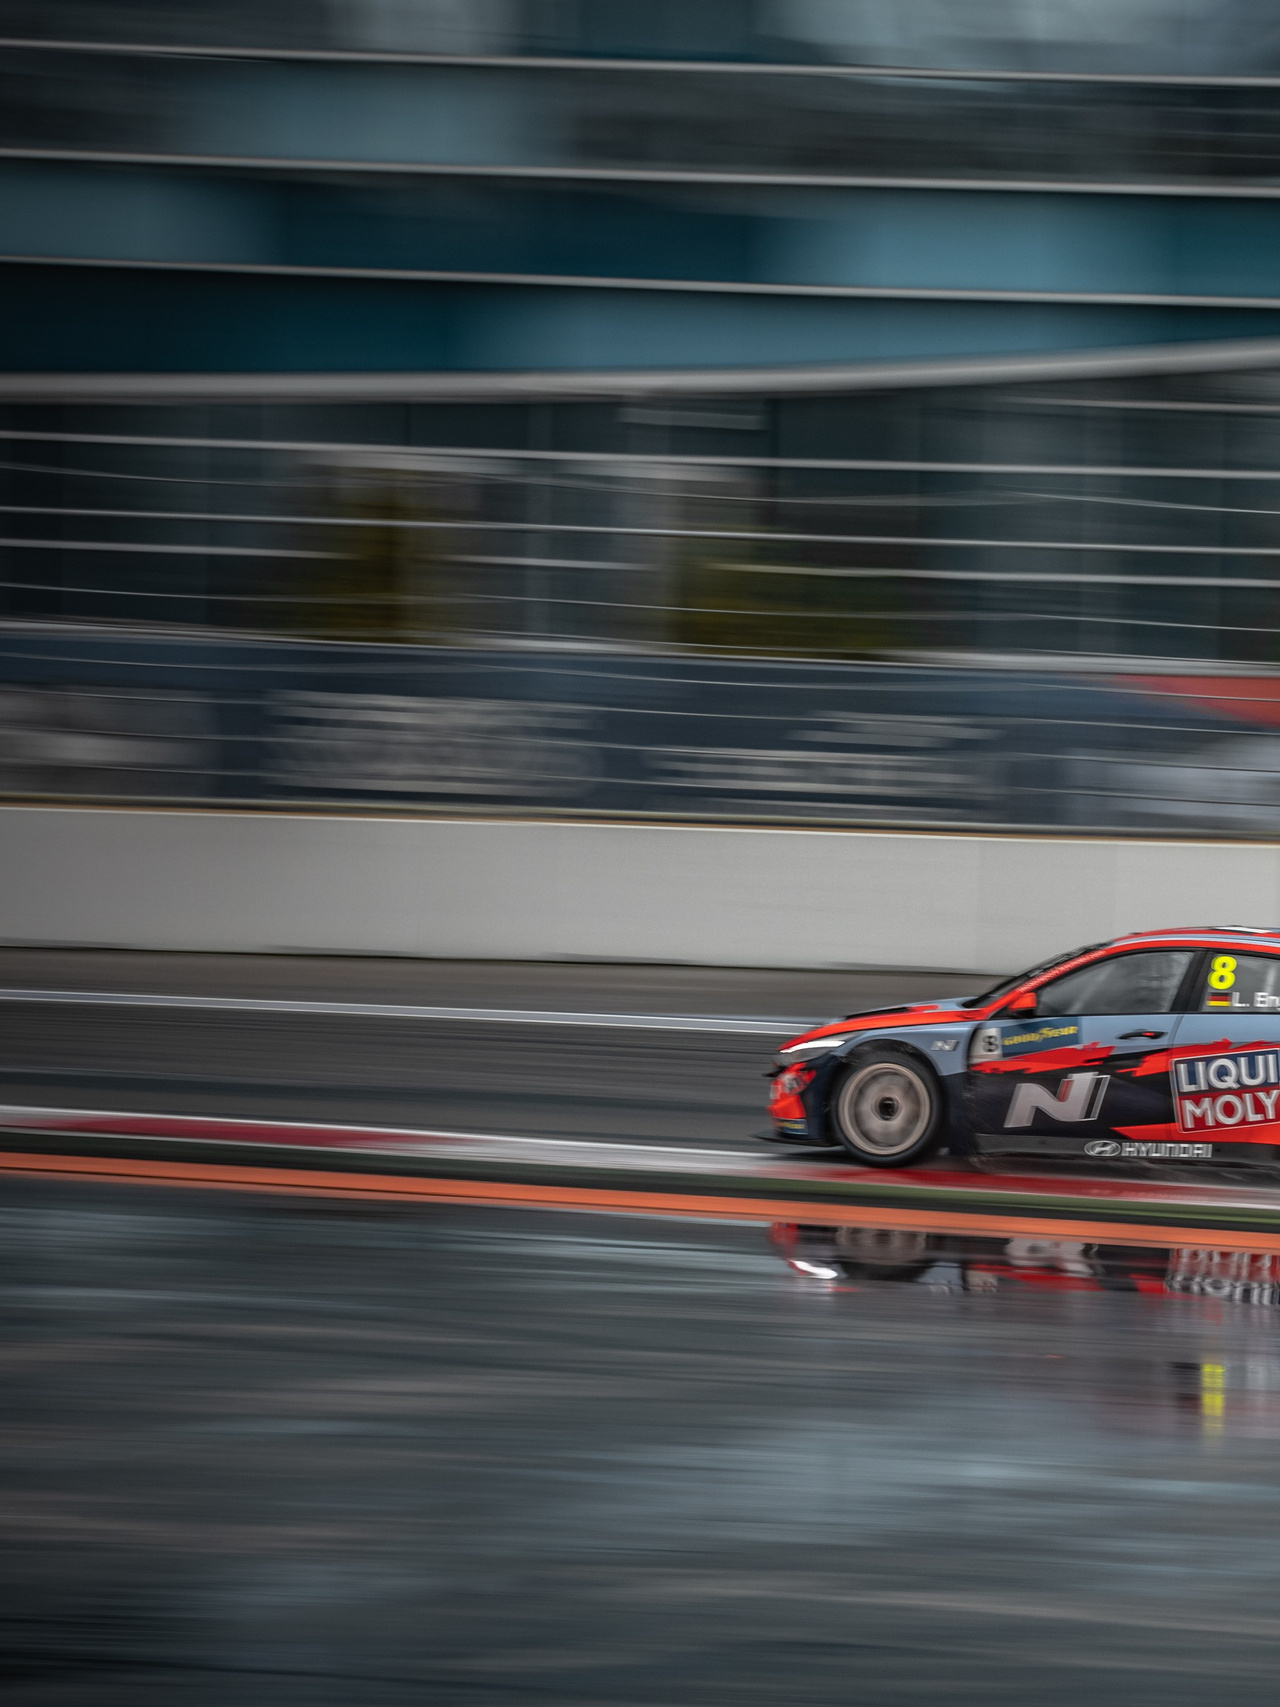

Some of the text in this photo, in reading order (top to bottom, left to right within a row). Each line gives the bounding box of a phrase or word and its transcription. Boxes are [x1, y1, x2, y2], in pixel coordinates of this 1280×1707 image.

[1208, 955, 1237, 990] 8
[1232, 992, 1250, 1008] L.
[982, 1035, 1000, 1053] 8
[1176, 1053, 1279, 1093] LIQUI
[1120, 1142, 1213, 1159] HYUNDAI
